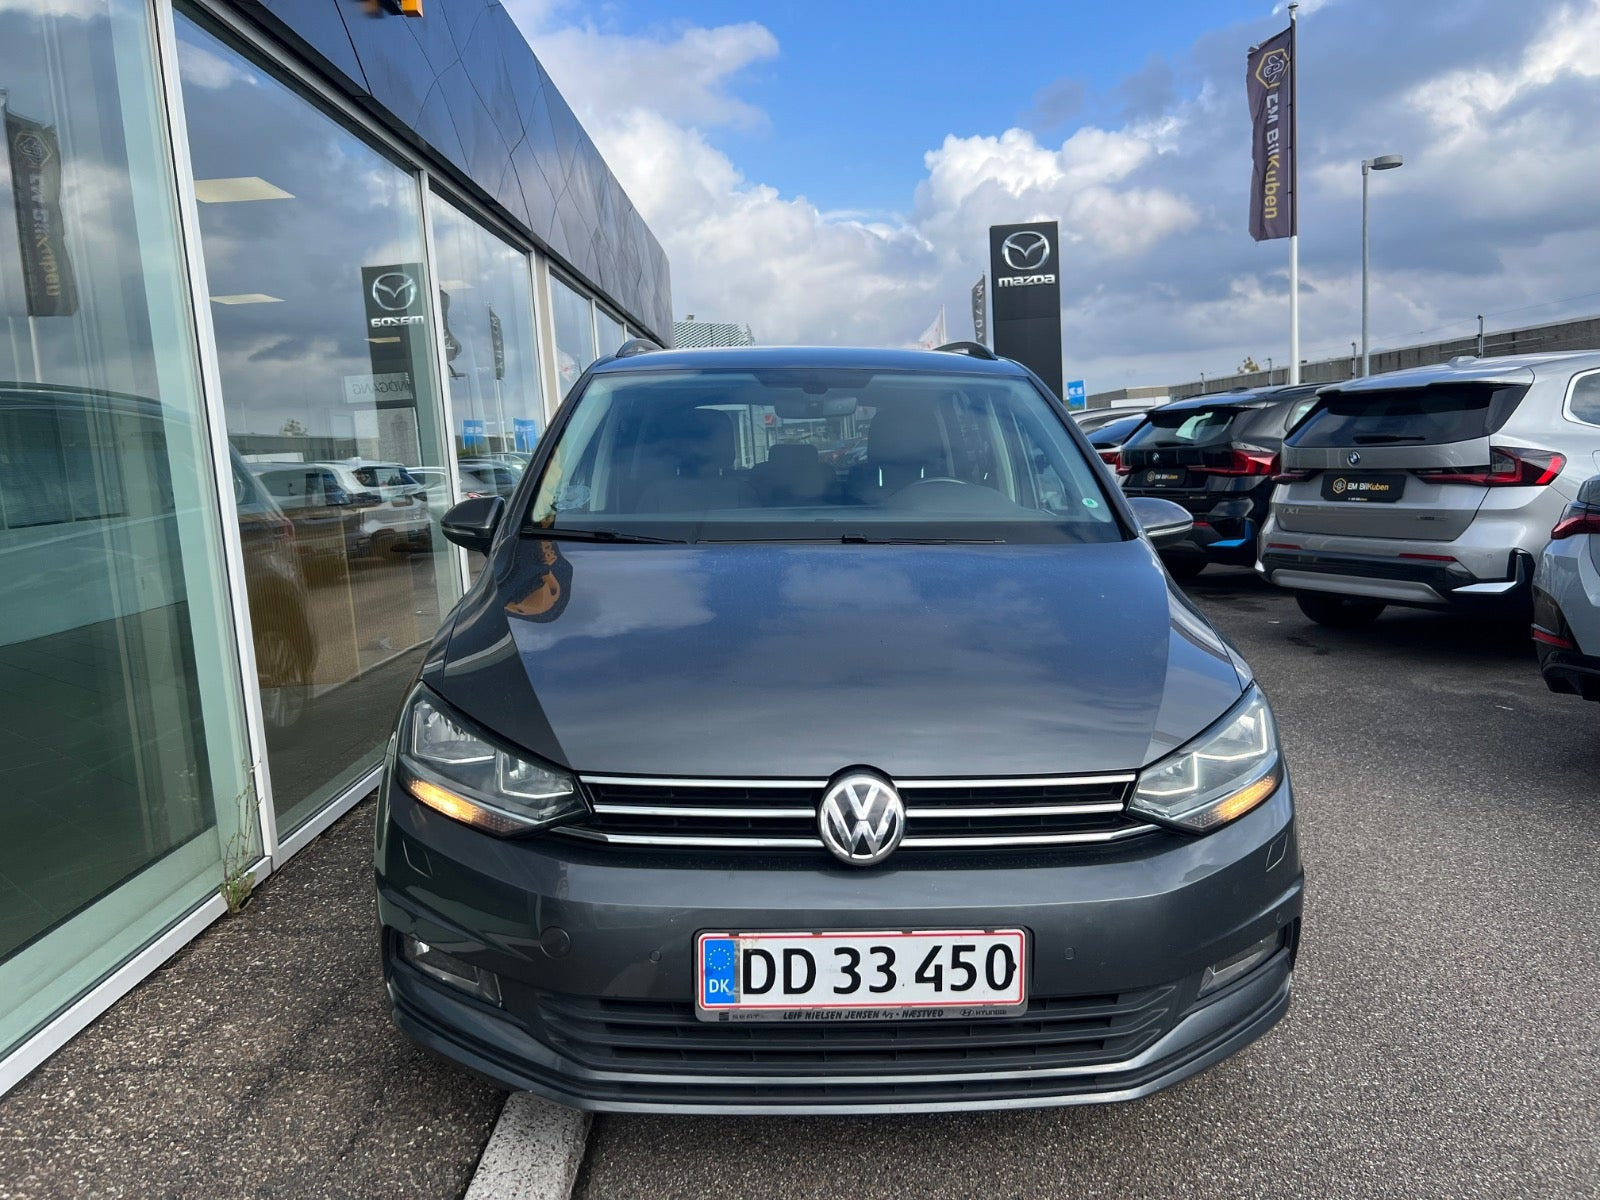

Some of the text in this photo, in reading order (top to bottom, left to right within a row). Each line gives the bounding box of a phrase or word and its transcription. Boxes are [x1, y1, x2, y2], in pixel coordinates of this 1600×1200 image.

[1264, 130, 1280, 219] BilKuben
[998, 274, 1055, 287] mazda
[1347, 482, 1389, 491] EM BilKuben
[742, 943, 1016, 995] DD 33 450
[709, 979, 730, 993] DK
[783, 1011, 803, 1020] LEIF
[804, 1011, 843, 1020] NIELSEN
[844, 1010, 880, 1019] JENSEN
[902, 1009, 944, 1018] NÆSTVED
